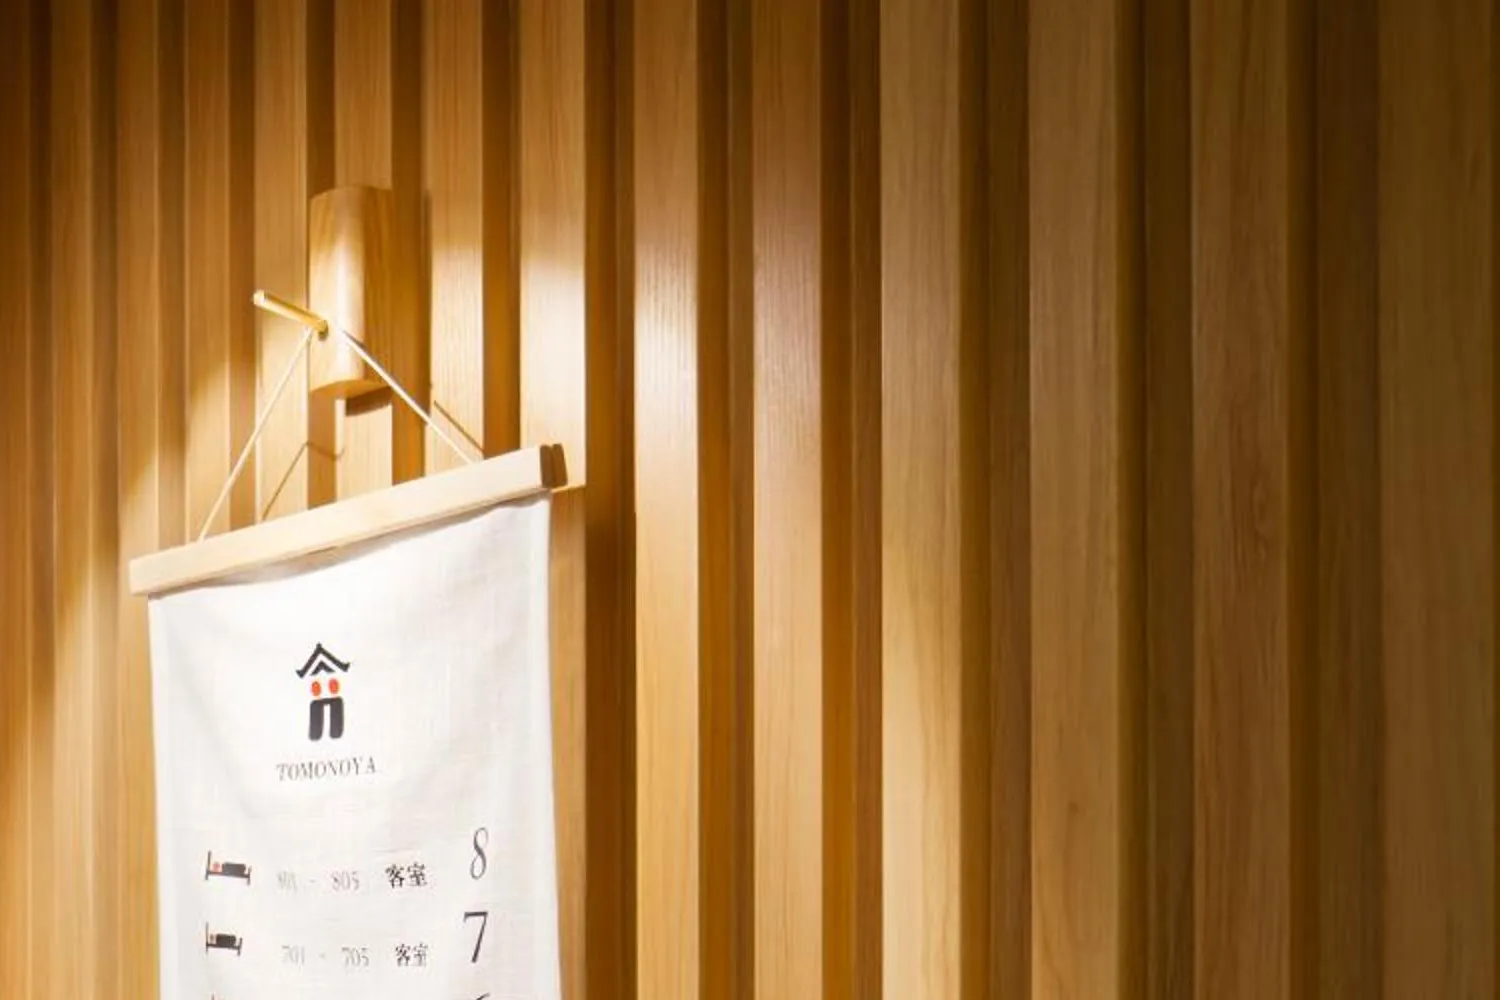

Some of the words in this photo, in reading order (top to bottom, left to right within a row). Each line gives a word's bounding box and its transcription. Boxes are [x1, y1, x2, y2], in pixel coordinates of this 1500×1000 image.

[276, 756, 376, 781] TOMONOYA
[331, 870, 360, 892] 805
[385, 861, 428, 889] 客室
[469, 827, 489, 880] 8
[341, 945, 370, 968] 705
[395, 942, 428, 968] 客室
[463, 911, 489, 964] 7
